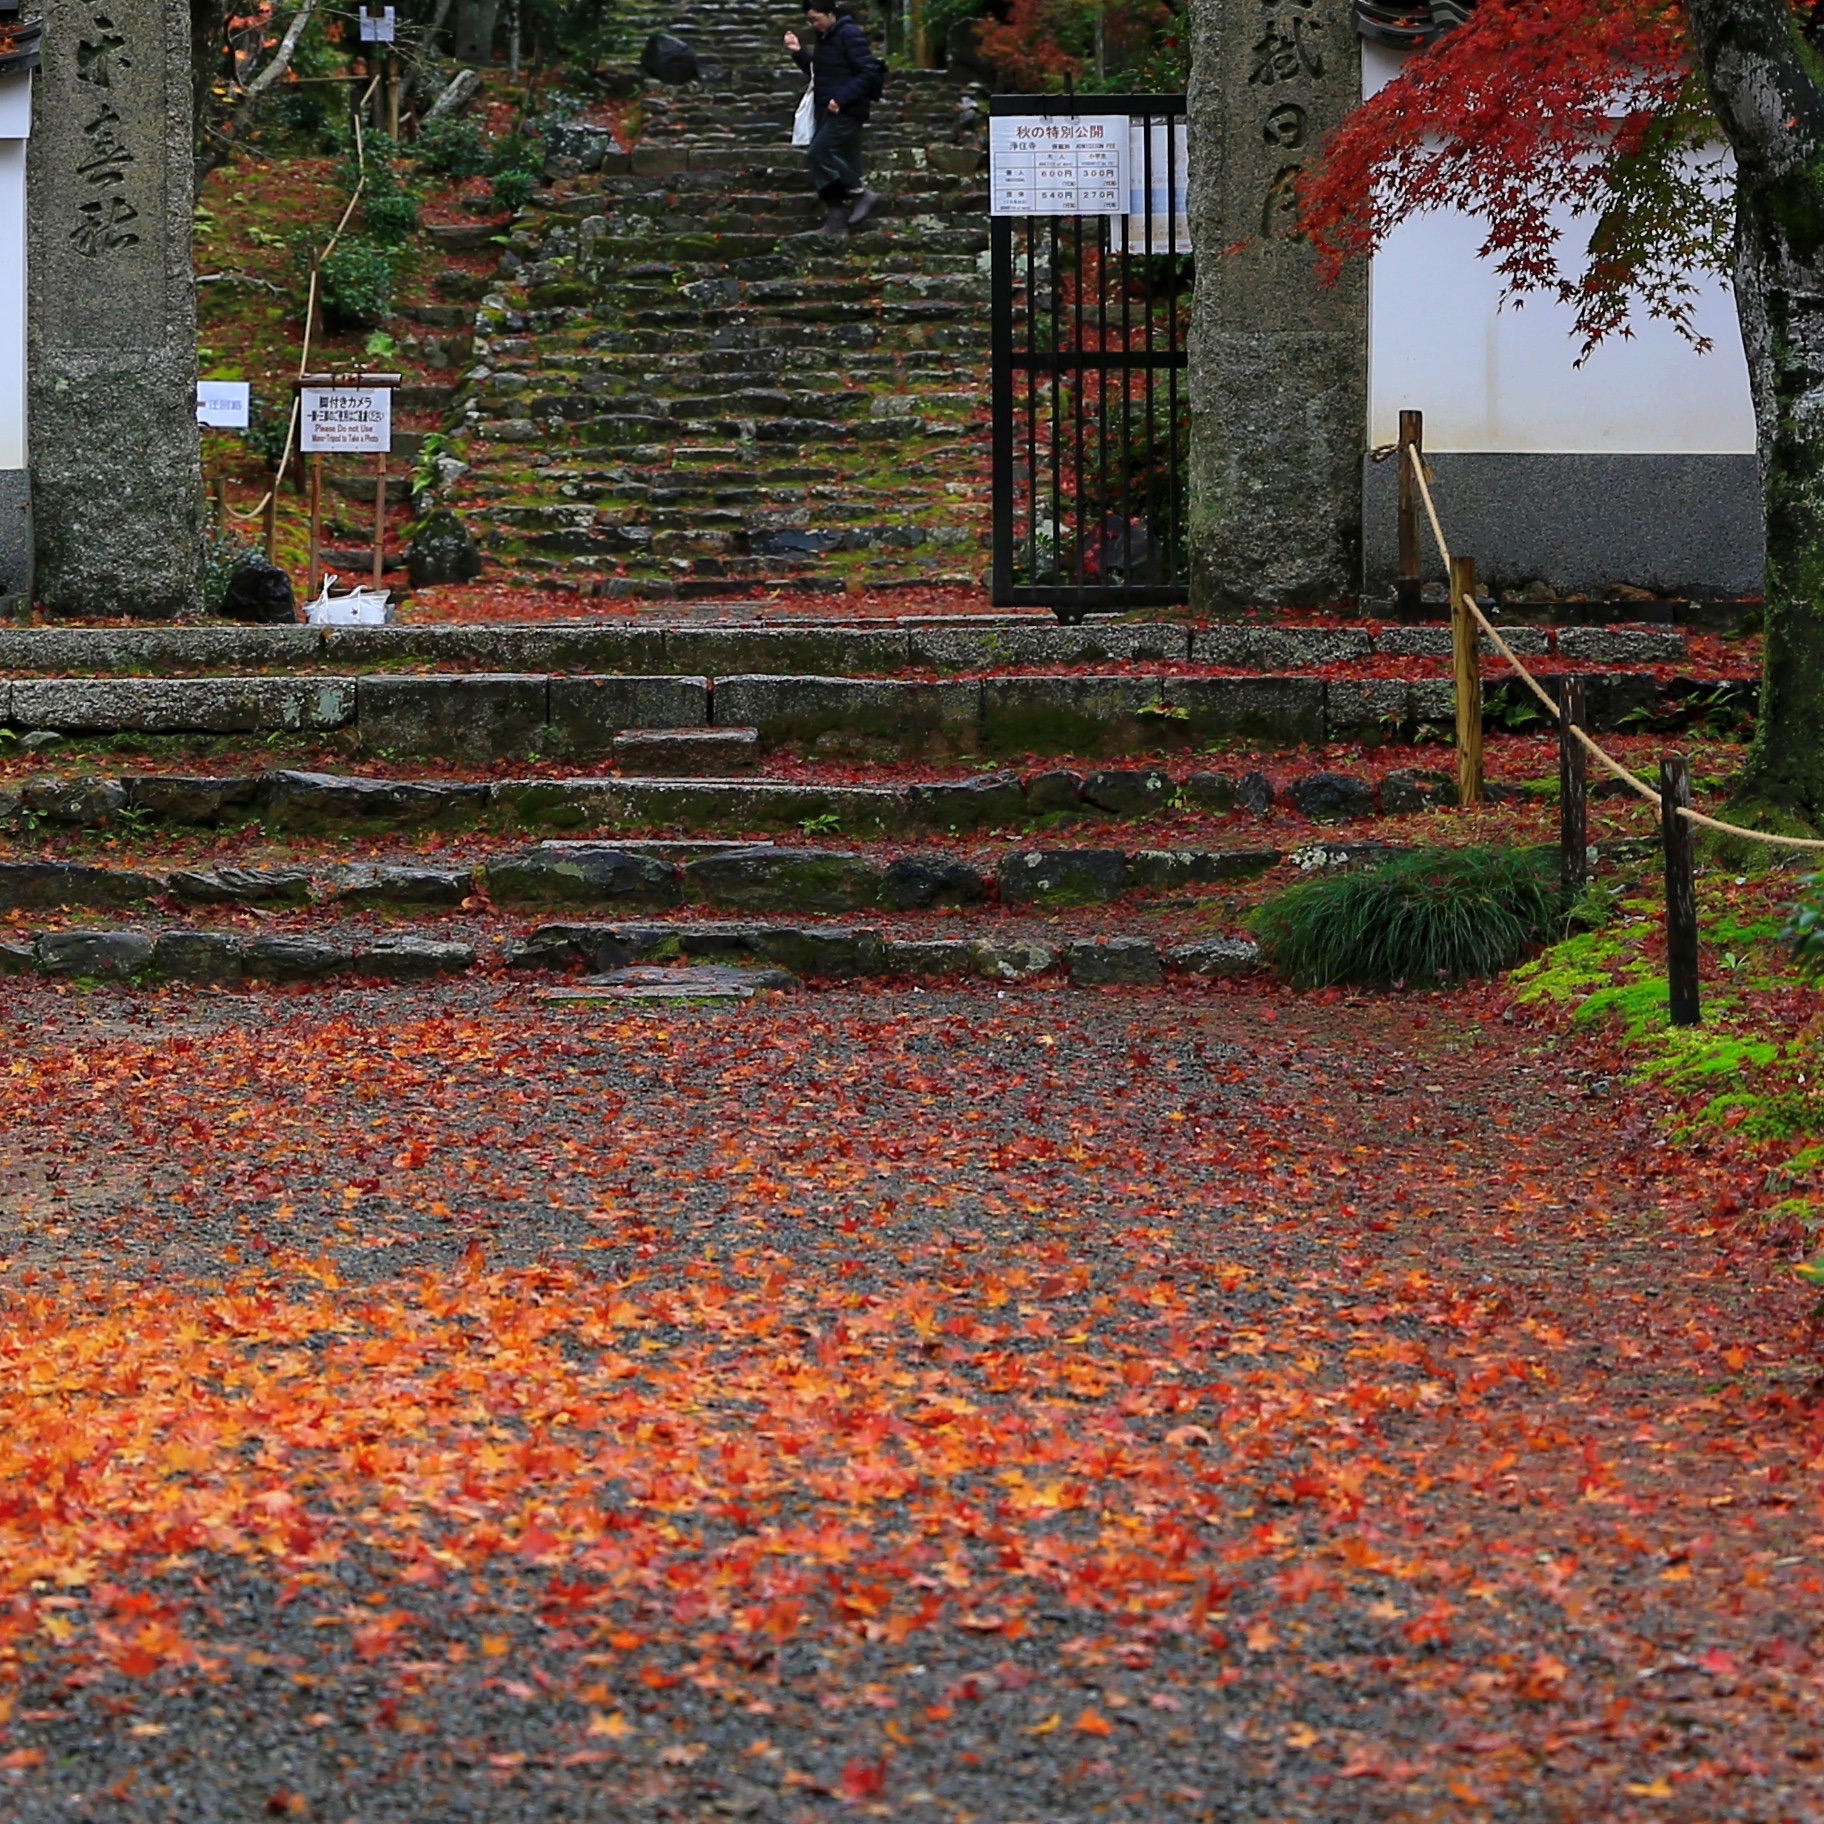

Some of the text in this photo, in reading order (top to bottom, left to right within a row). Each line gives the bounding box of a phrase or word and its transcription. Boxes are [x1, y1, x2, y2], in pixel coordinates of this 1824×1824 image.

[1016, 125, 1104, 139] 秋の特別公開
[1041, 170, 1072, 178] 600円
[1083, 169, 1114, 178] 300円
[1083, 191, 1114, 199] 270円
[315, 424, 373, 432] Please Do not Use
